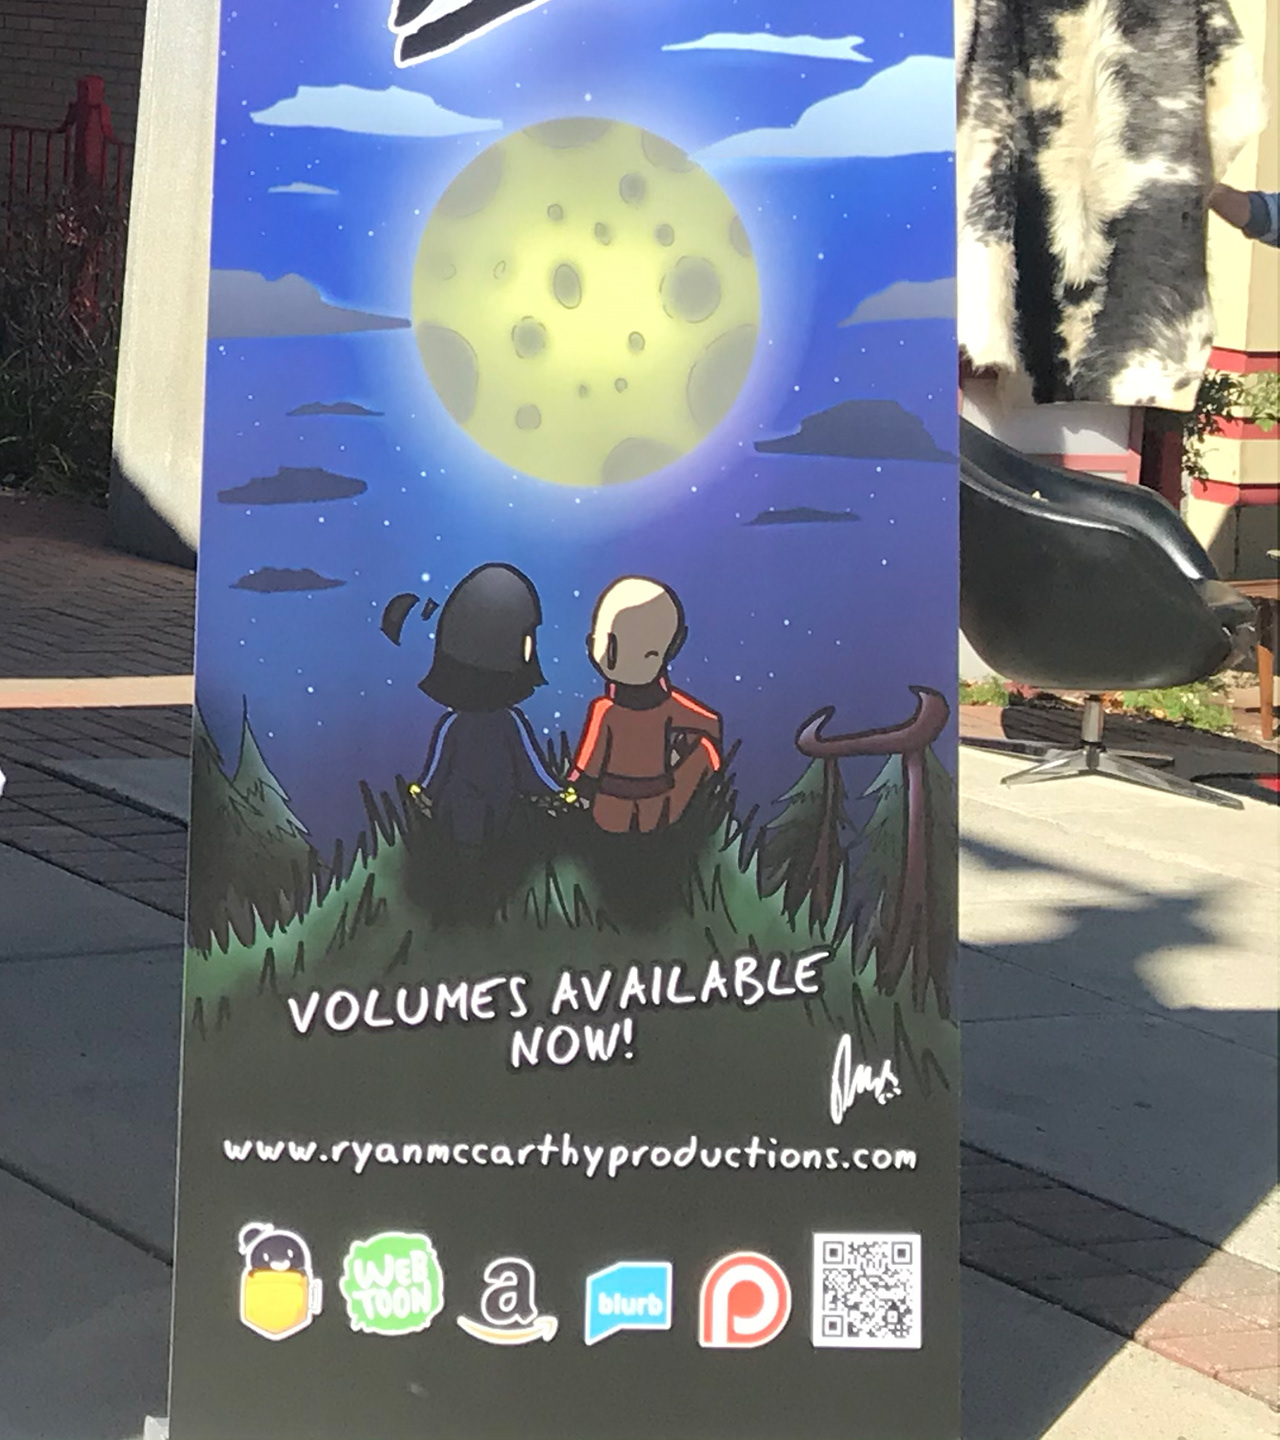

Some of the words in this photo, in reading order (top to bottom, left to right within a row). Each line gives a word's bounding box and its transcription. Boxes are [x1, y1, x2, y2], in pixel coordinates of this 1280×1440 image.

[288, 977, 528, 1036] VOLUMES
[550, 952, 831, 1017] AVAILABLE
[510, 1019, 634, 1068] NOW!
[222, 1133, 918, 1179] www.ryanmccarthyproductions.com
[597, 1291, 664, 1317] blurb
